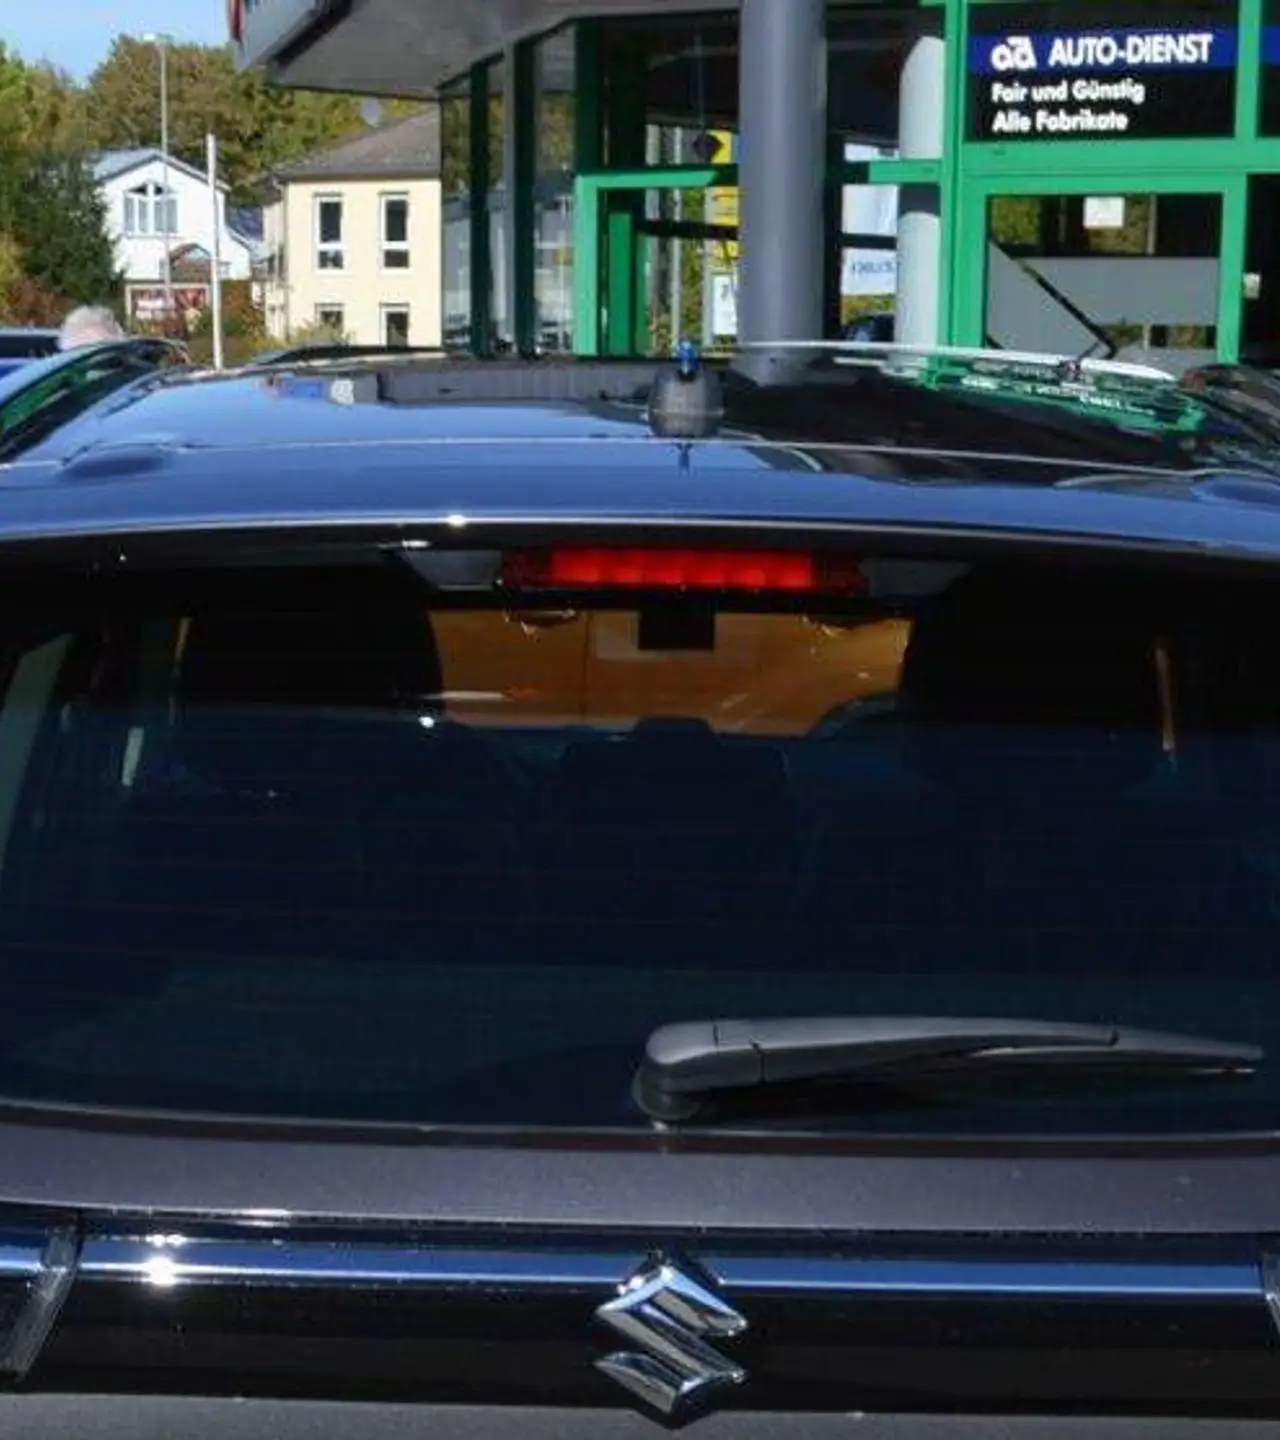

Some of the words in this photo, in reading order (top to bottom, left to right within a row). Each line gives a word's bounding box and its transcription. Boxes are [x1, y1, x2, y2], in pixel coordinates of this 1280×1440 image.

[1048, 33, 1213, 66] AUTO-DIENST
[991, 82, 1027, 102] Fair
[1031, 81, 1068, 101] und
[1072, 78, 1145, 104] Günstig
[992, 110, 1031, 132] Alle
[1036, 109, 1128, 131] Fabrikate
